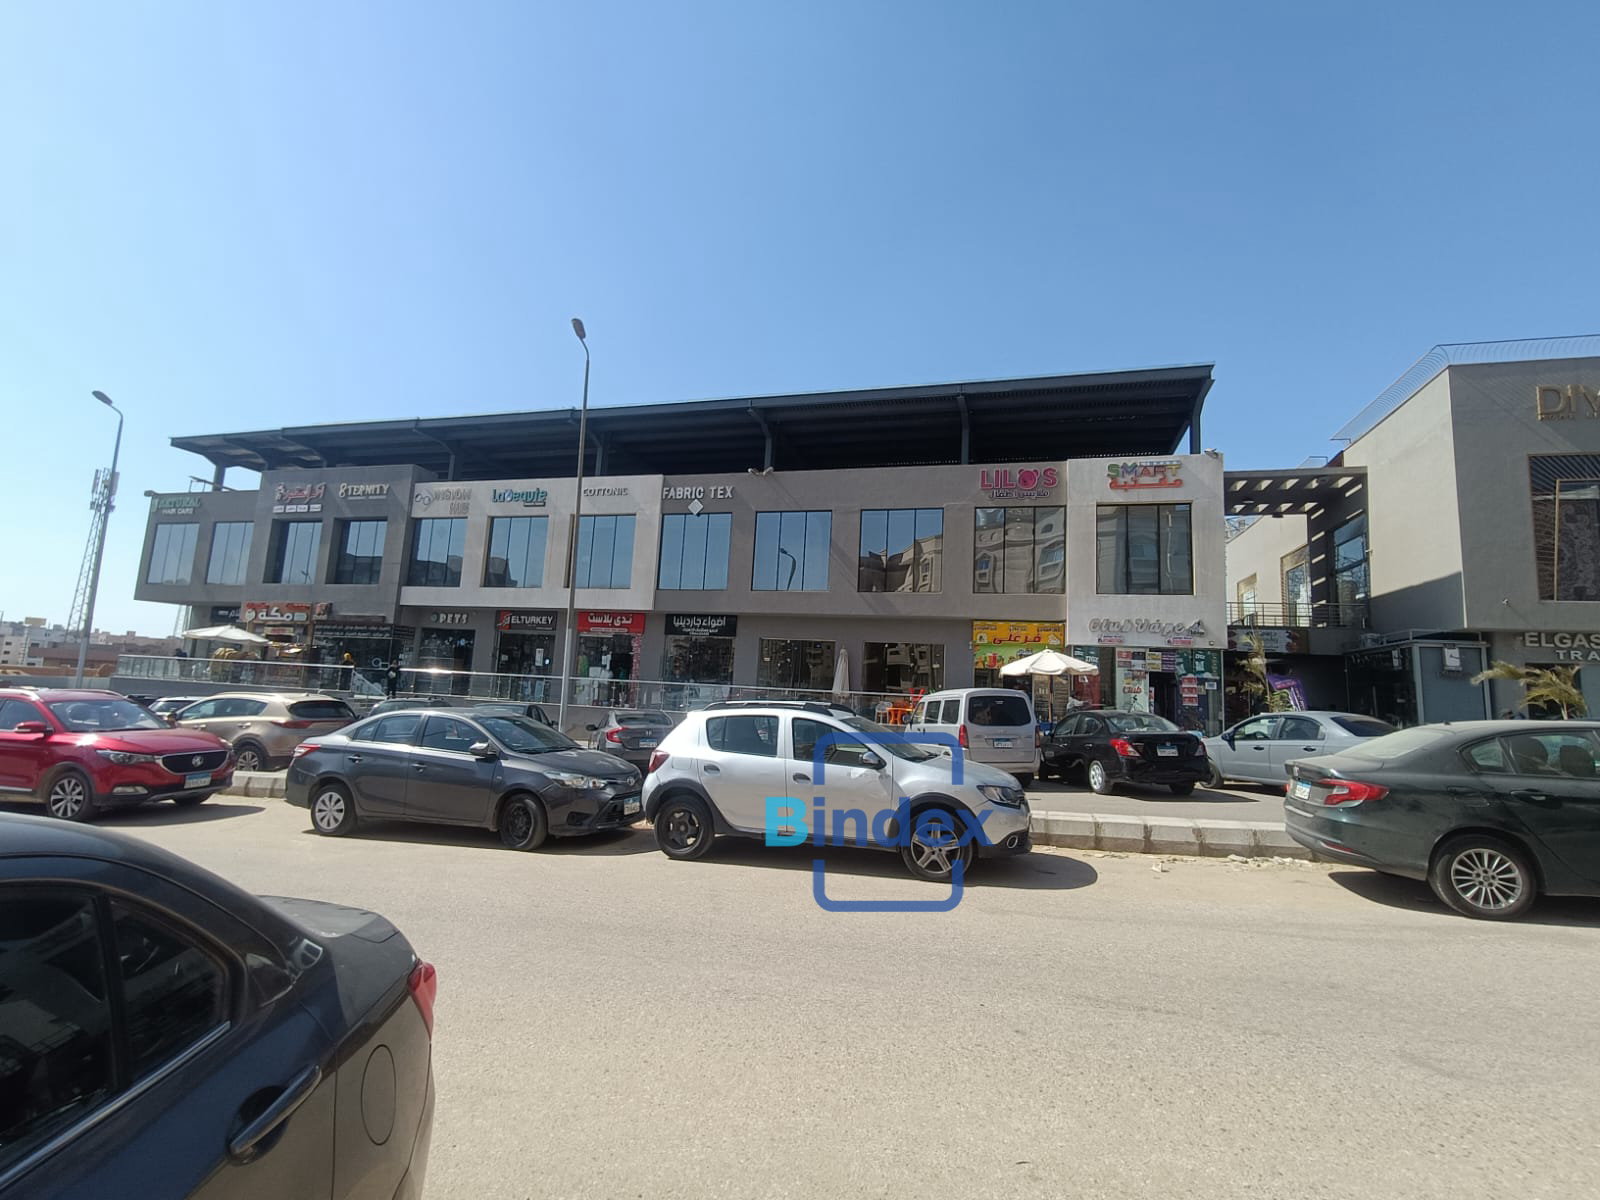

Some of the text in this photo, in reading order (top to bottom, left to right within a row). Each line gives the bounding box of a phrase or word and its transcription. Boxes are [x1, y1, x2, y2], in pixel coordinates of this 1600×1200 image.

[1107, 462, 1181, 478] SMART
[980, 467, 1057, 490] LILOS
[662, 486, 734, 499] FABRIC TEX
[438, 613, 468, 624] PETS
[511, 615, 553, 625] ELTURKEY
[1089, 618, 1134, 633] Club
[1524, 632, 1600, 649] ELGAS
[1555, 649, 1600, 661] TRA
